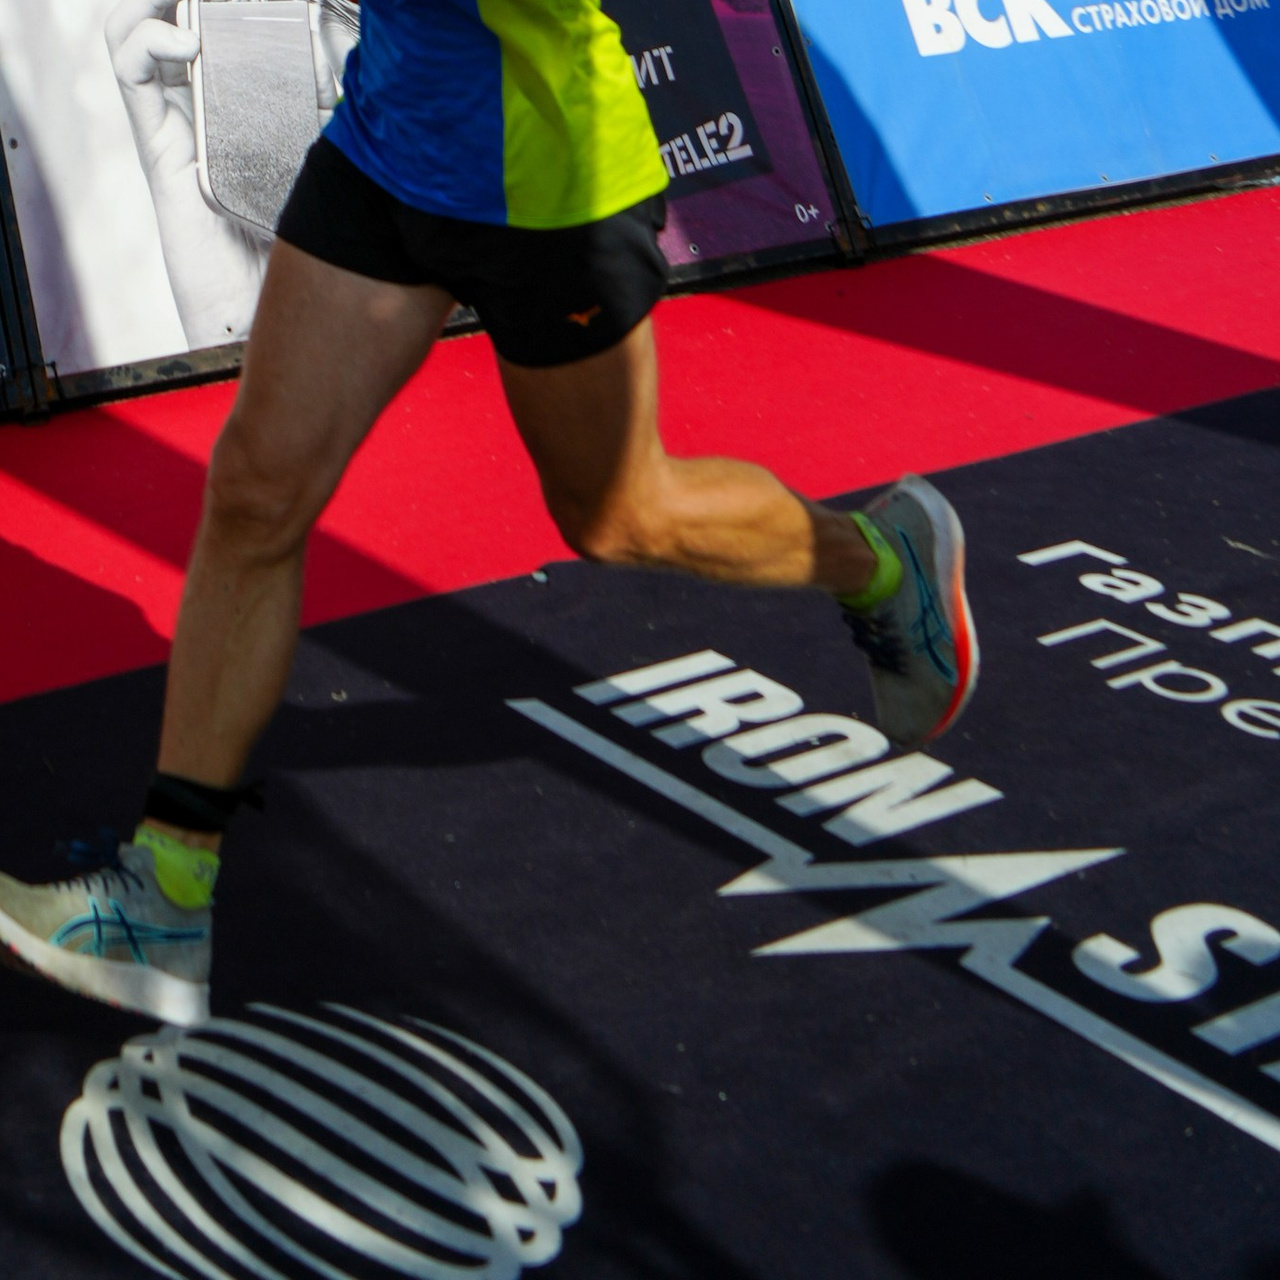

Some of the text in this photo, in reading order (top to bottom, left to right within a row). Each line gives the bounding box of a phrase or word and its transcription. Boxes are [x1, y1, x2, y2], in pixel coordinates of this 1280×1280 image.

[659, 111, 754, 179] TELE2
[794, 203, 821, 224] 0+
[1016, 539, 1280, 677] Газп
[573, 649, 1004, 847] IRON
